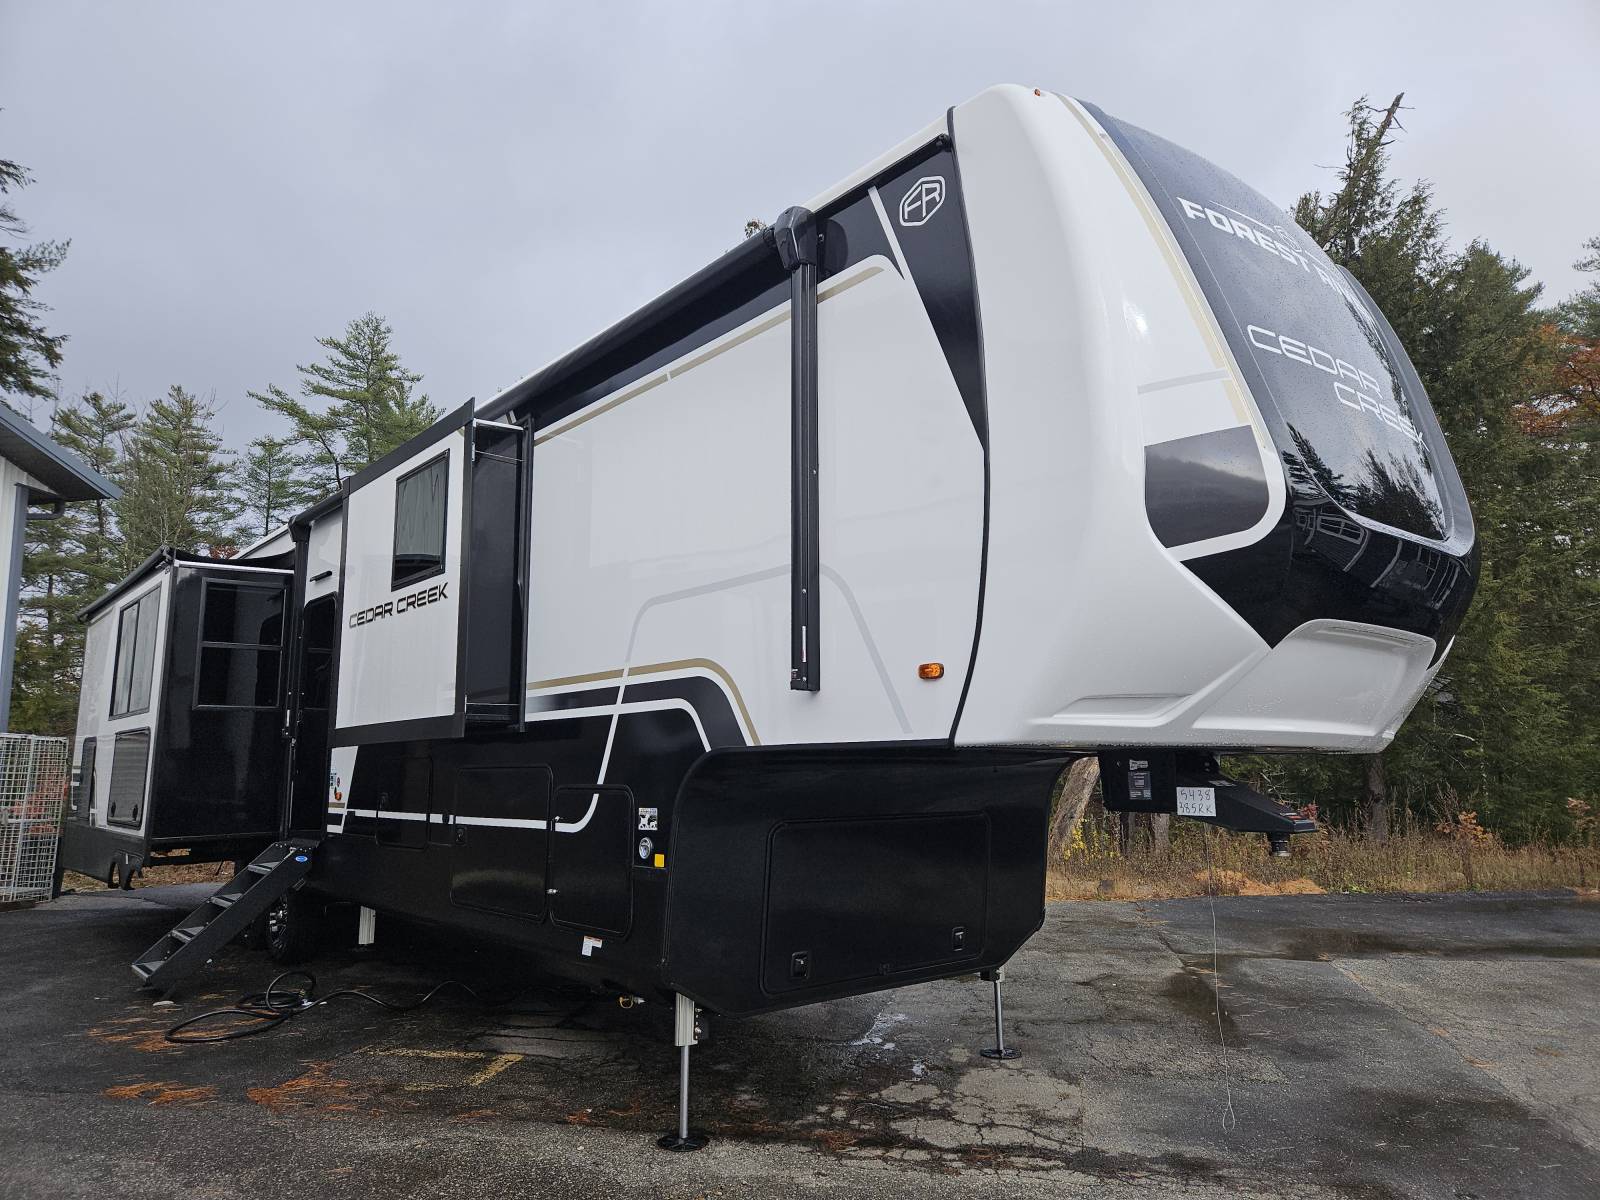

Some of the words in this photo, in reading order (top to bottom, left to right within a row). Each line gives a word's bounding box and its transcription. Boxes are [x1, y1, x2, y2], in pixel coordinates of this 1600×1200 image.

[1176, 196, 1310, 273] FOREST
[1247, 324, 1384, 399] CEDAR
[1333, 381, 1431, 453] CREEK
[349, 601, 394, 629] CEDAR
[396, 582, 449, 614] CREEK
[1180, 789, 1211, 801] 5438
